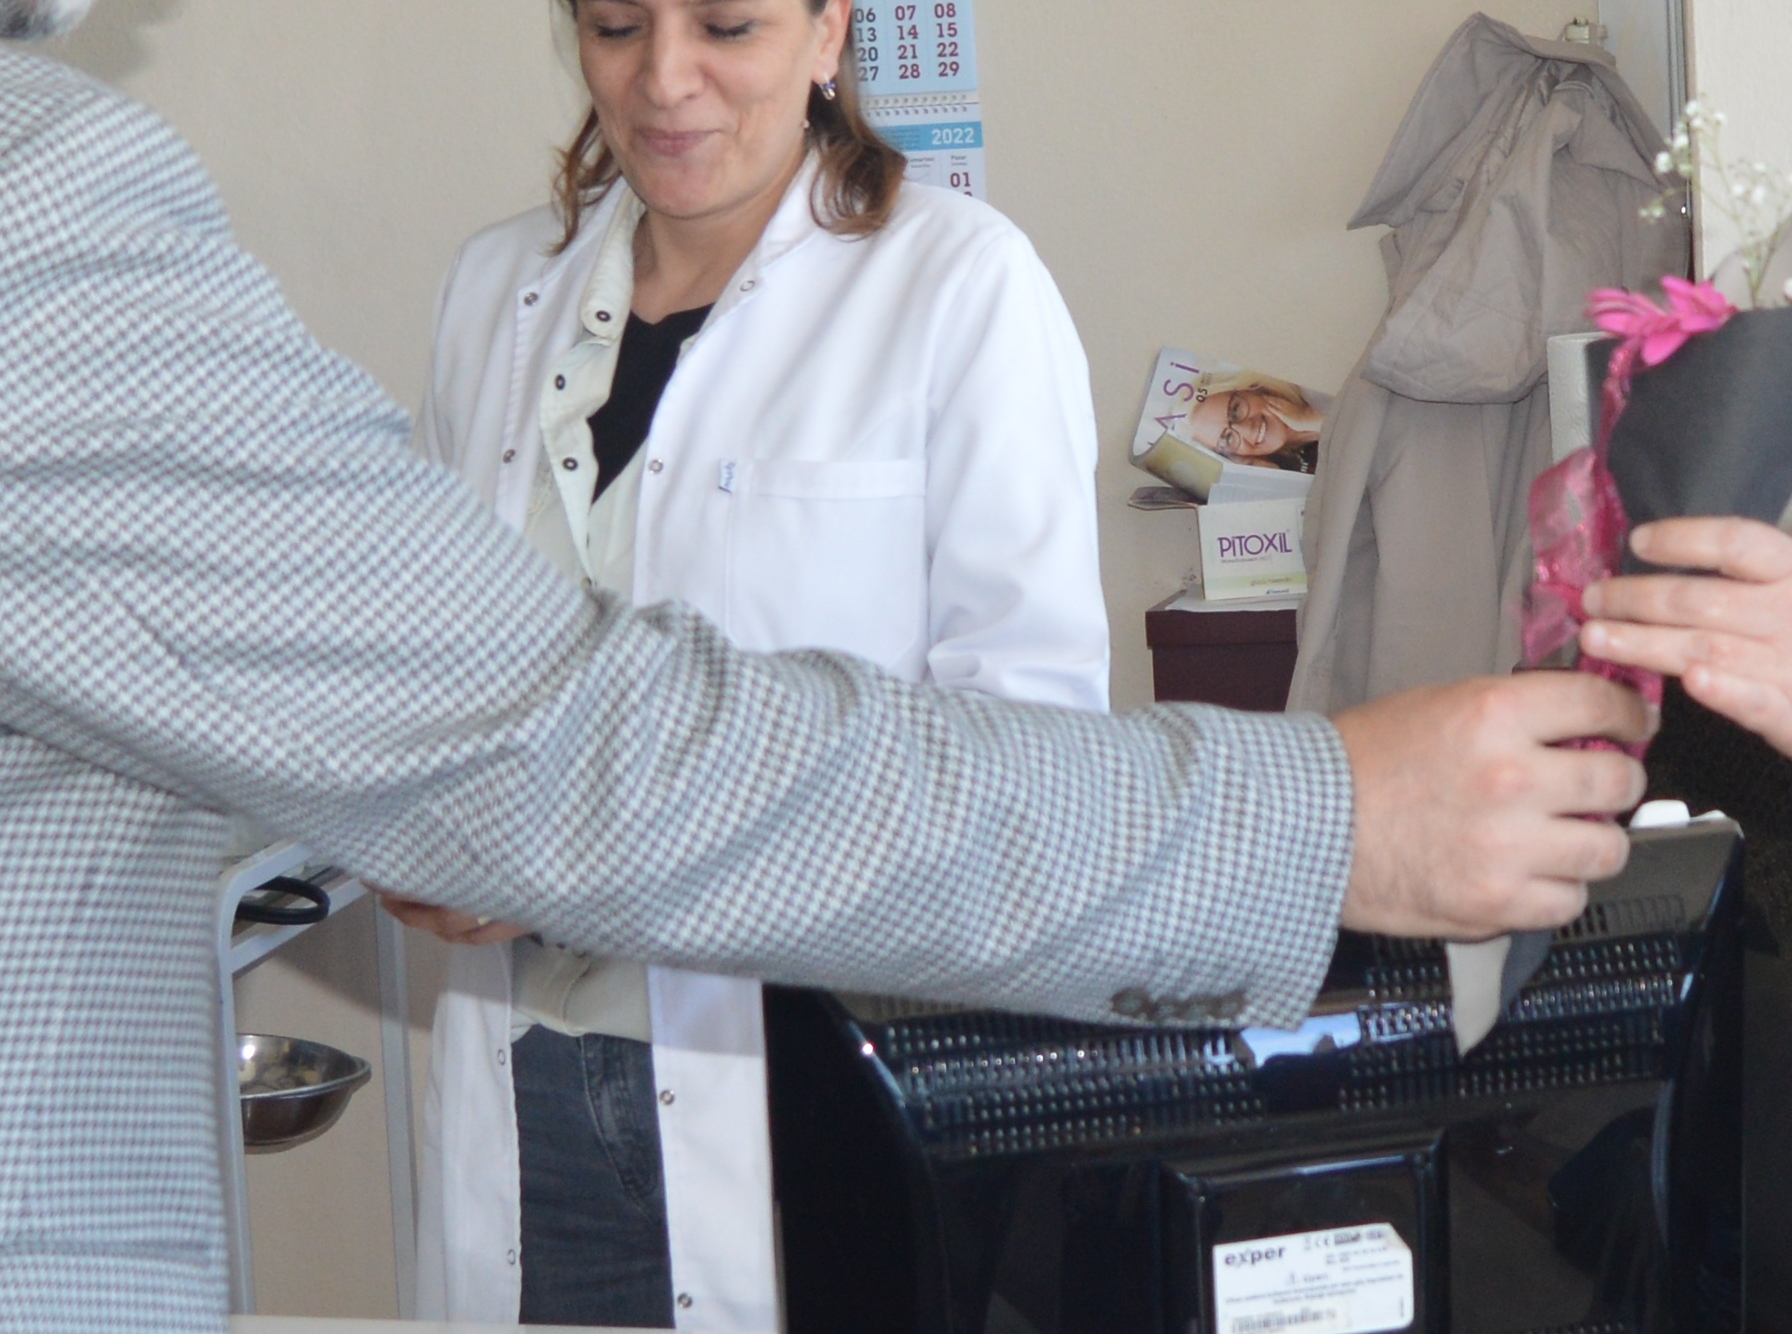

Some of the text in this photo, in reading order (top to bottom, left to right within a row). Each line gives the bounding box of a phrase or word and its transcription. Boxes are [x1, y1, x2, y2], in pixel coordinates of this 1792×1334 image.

[855, 3, 956, 23] 06 07 08
[857, 22, 958, 43] 13 14 15
[858, 42, 959, 62] 20 21 22
[859, 61, 960, 81] 27 28 29
[931, 127, 975, 145] 2022
[950, 172, 971, 187] 01
[1224, 1245, 1286, 1267] exper
